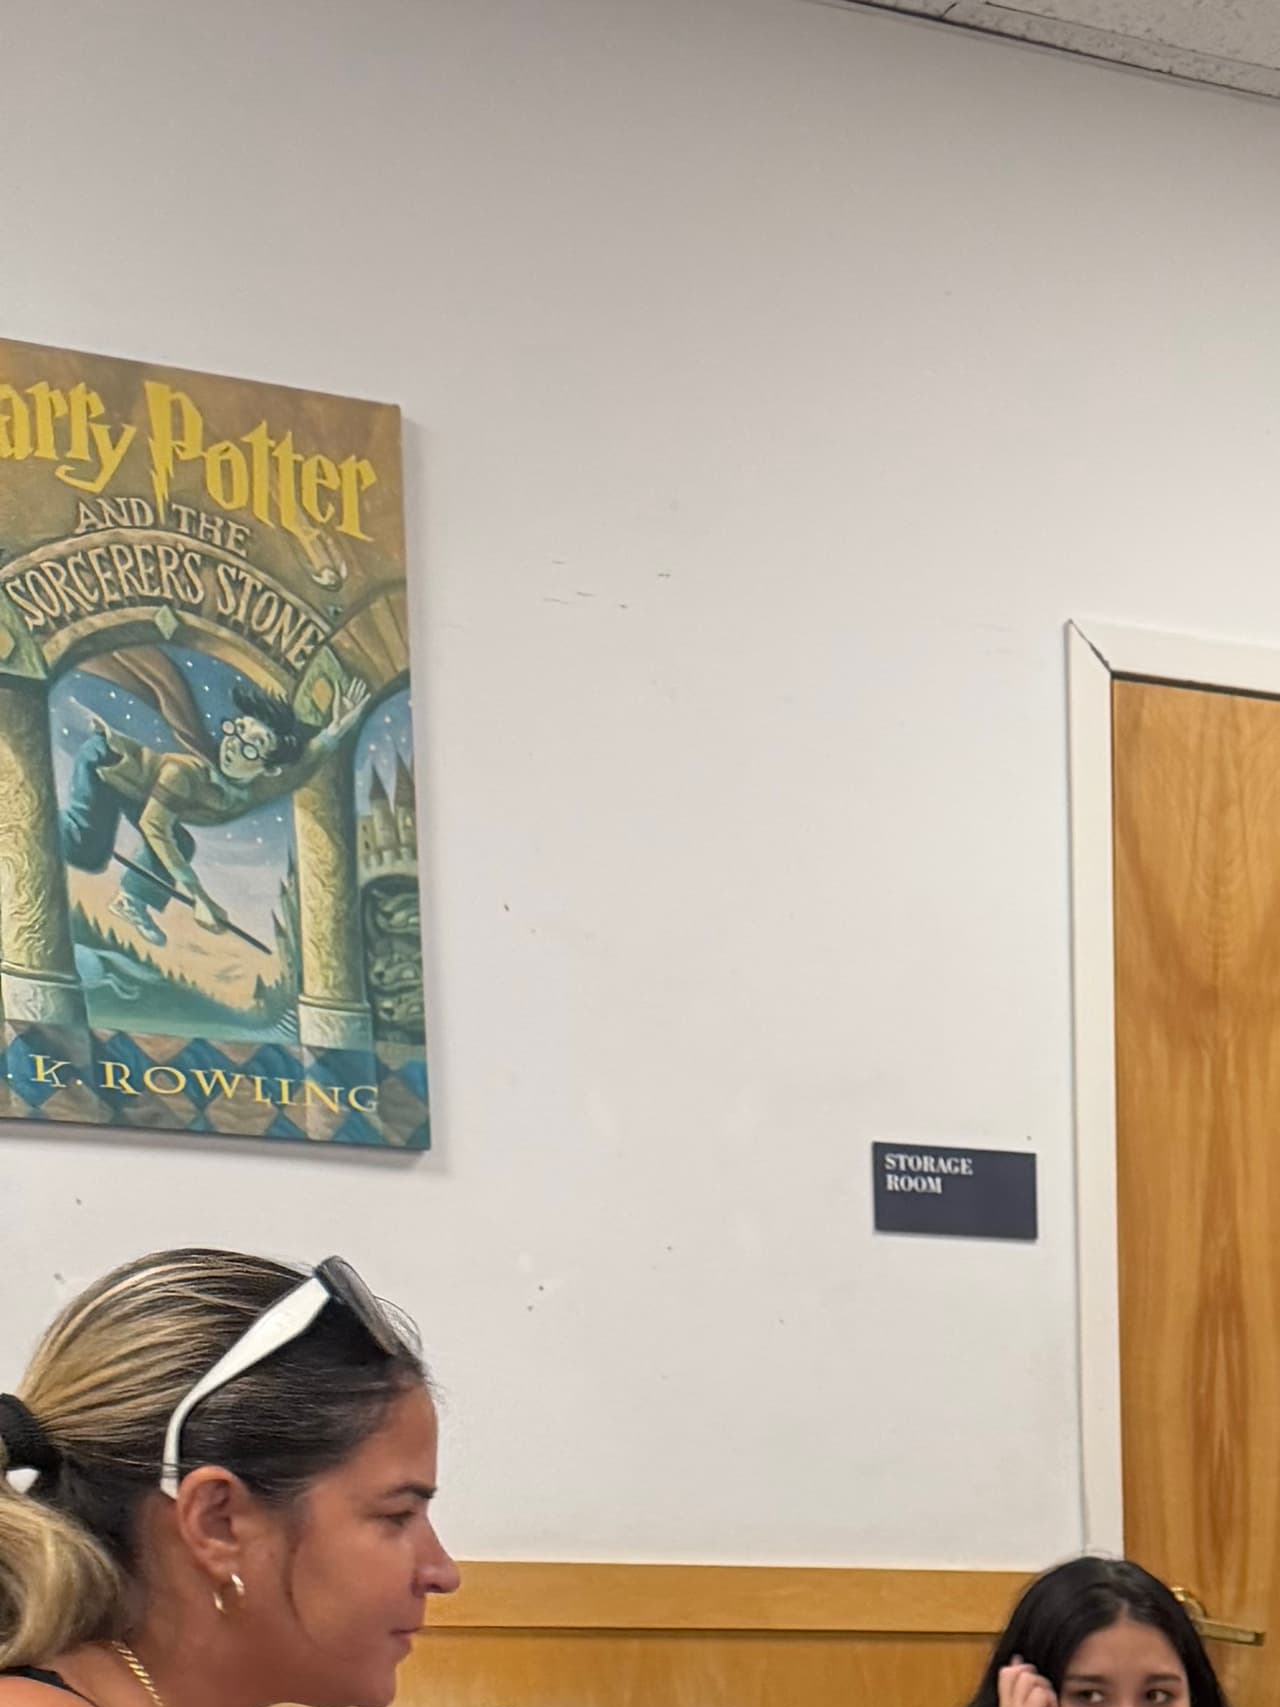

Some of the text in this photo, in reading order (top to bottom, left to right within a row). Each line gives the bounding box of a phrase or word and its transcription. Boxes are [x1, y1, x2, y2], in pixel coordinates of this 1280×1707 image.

[0, 380, 378, 540] arry Potter
[75, 496, 250, 557] AND THE
[6, 545, 326, 668] SORCERER'S STONE
[103, 1061, 381, 1115] ROWLING
[884, 1152, 974, 1177] STORAGE
[885, 1173, 944, 1195] ROOM
